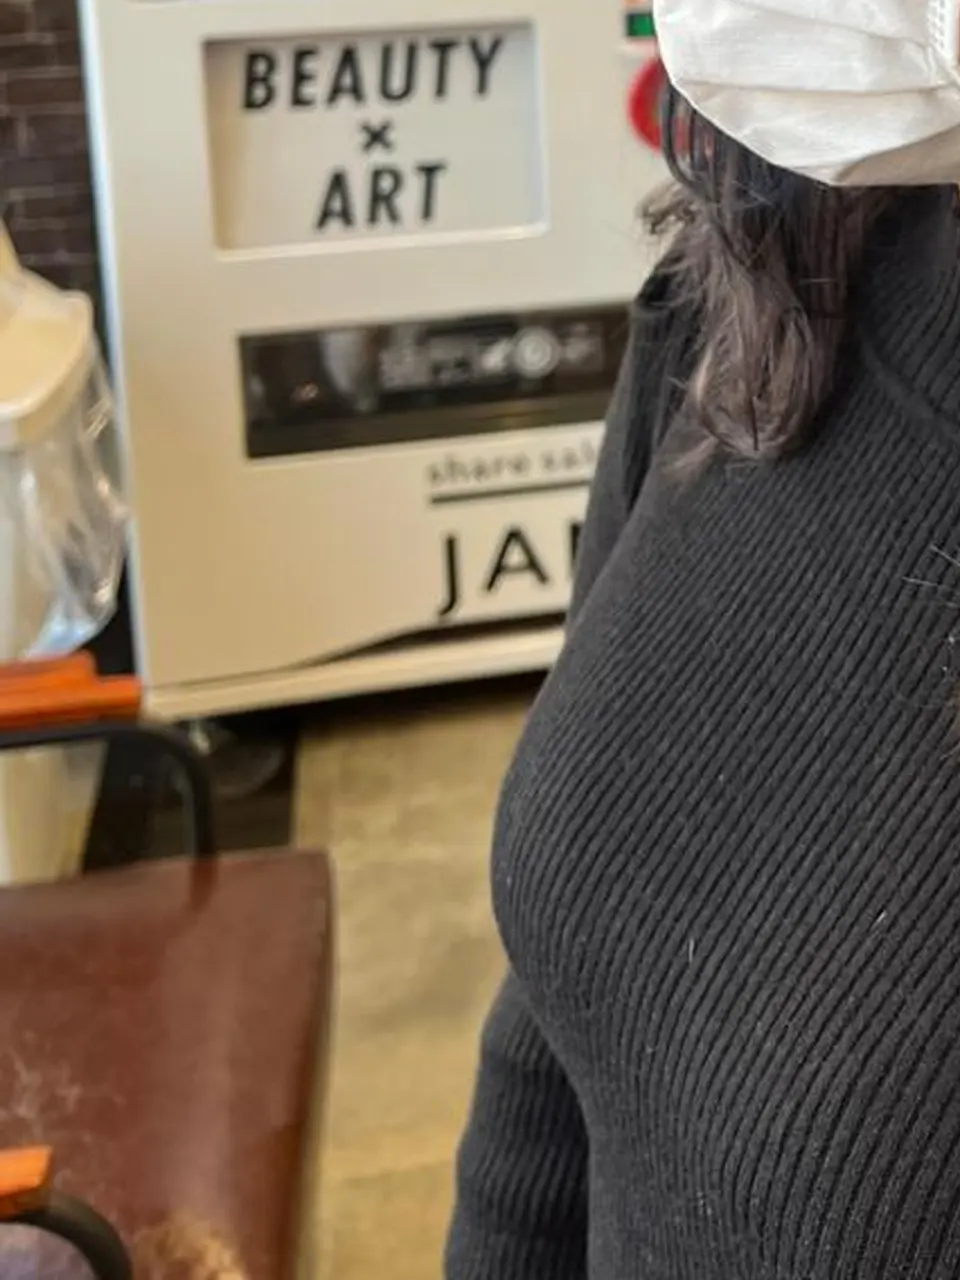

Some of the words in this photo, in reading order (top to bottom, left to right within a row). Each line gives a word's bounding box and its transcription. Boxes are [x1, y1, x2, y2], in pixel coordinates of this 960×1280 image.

[243, 37, 501, 110] BEAUTY
[316, 163, 446, 229] ART
[427, 455, 531, 485] share
